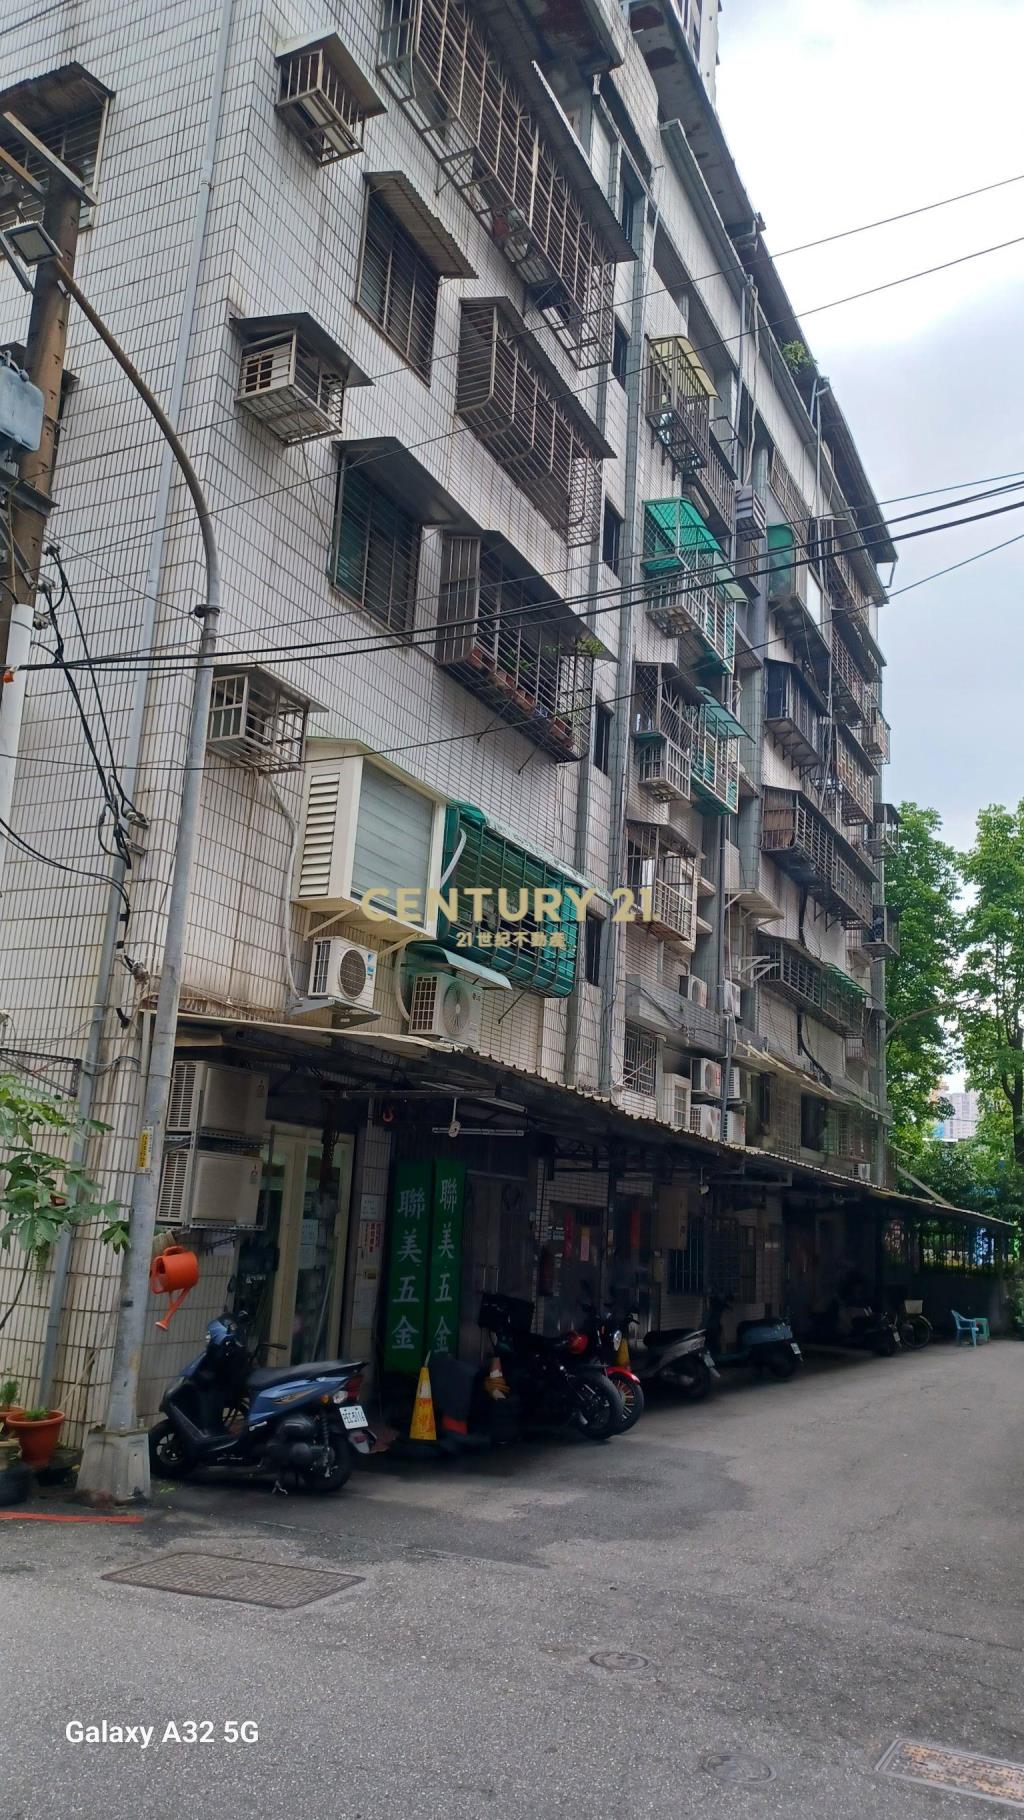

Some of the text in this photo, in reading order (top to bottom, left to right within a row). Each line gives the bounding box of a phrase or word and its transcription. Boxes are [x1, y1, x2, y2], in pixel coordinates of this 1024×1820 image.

[392, 1187, 425, 1350] 聯美五金
[434, 1178, 458, 1353] 聯美五金
